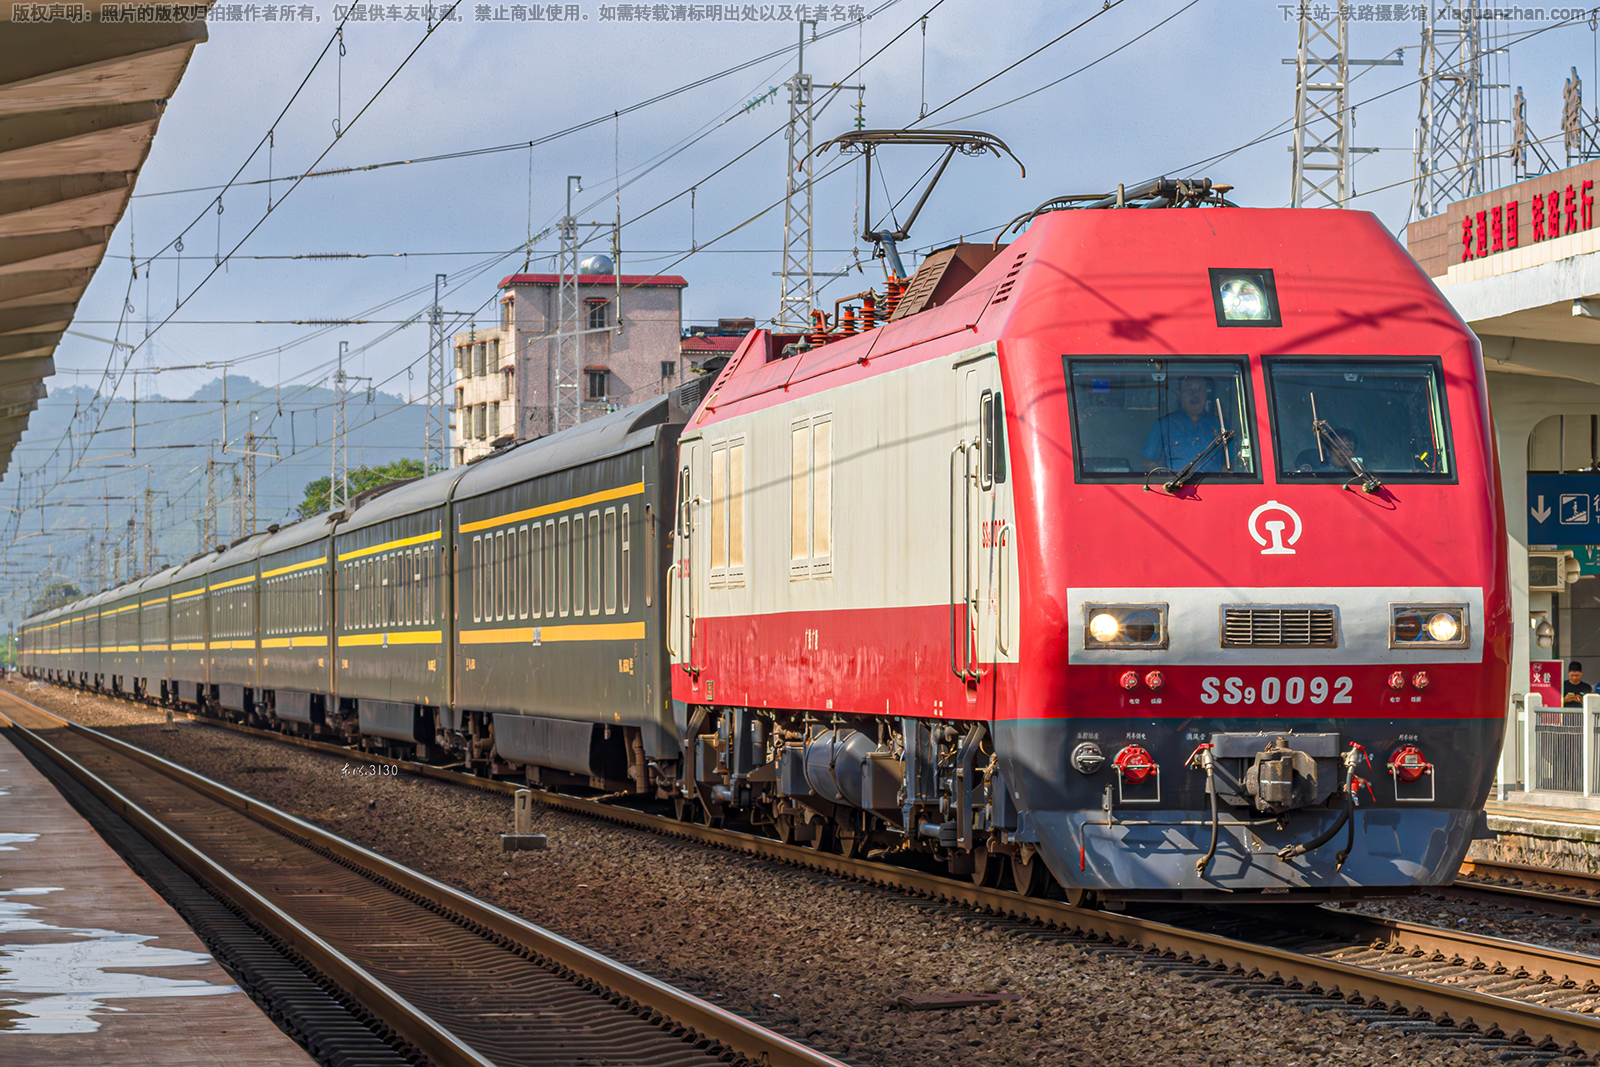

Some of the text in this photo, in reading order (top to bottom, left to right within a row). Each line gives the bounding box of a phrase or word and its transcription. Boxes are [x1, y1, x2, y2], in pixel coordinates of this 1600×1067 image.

[1461, 179, 1595, 263] 交通强国 铁路先行
